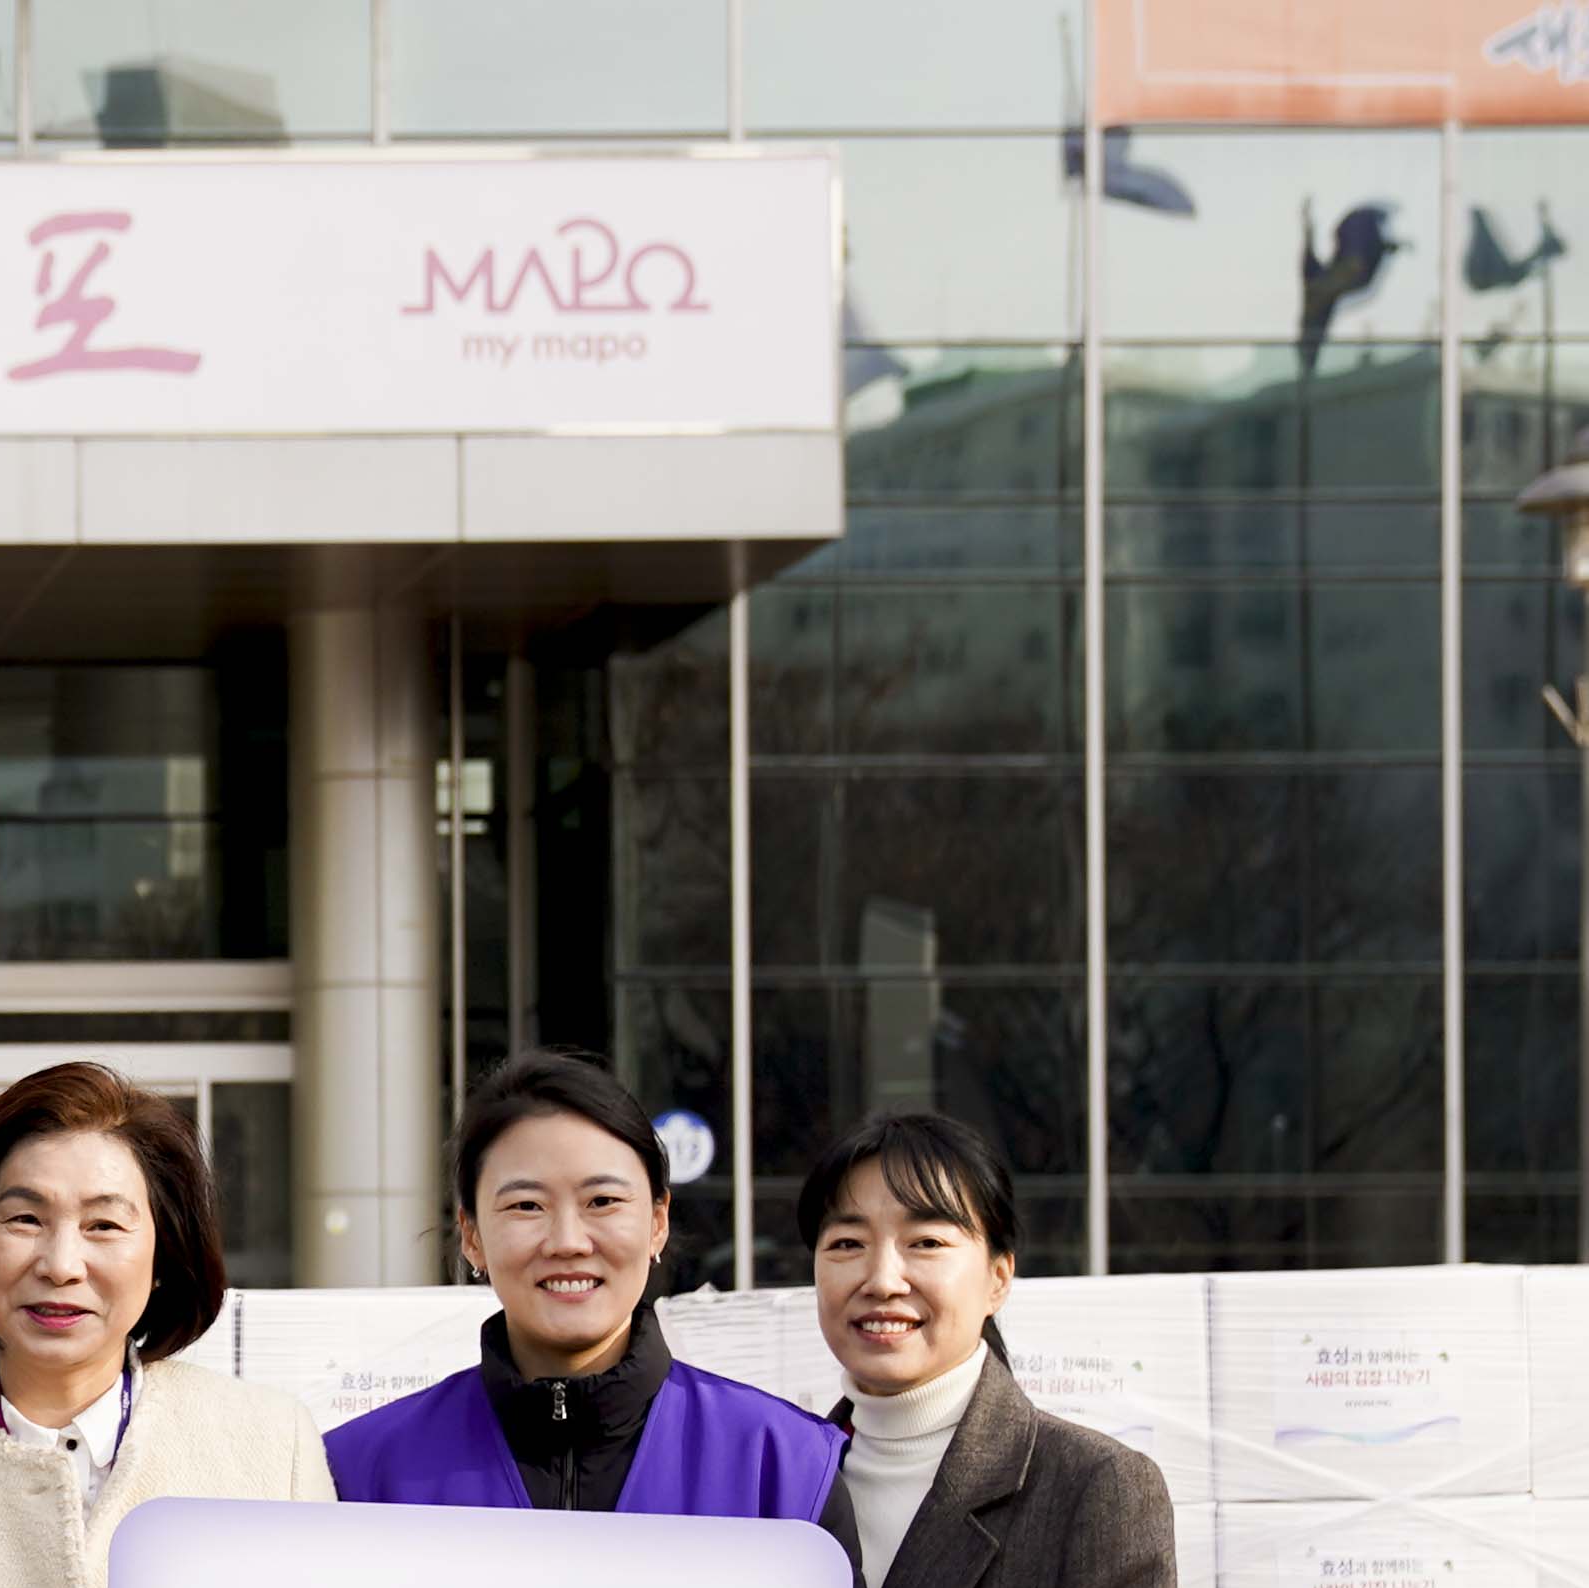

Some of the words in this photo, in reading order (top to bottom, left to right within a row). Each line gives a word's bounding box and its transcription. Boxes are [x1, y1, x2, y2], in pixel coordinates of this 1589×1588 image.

[398, 215, 710, 313] MAPO
[461, 335, 519, 367] my
[532, 335, 648, 366] mapo
